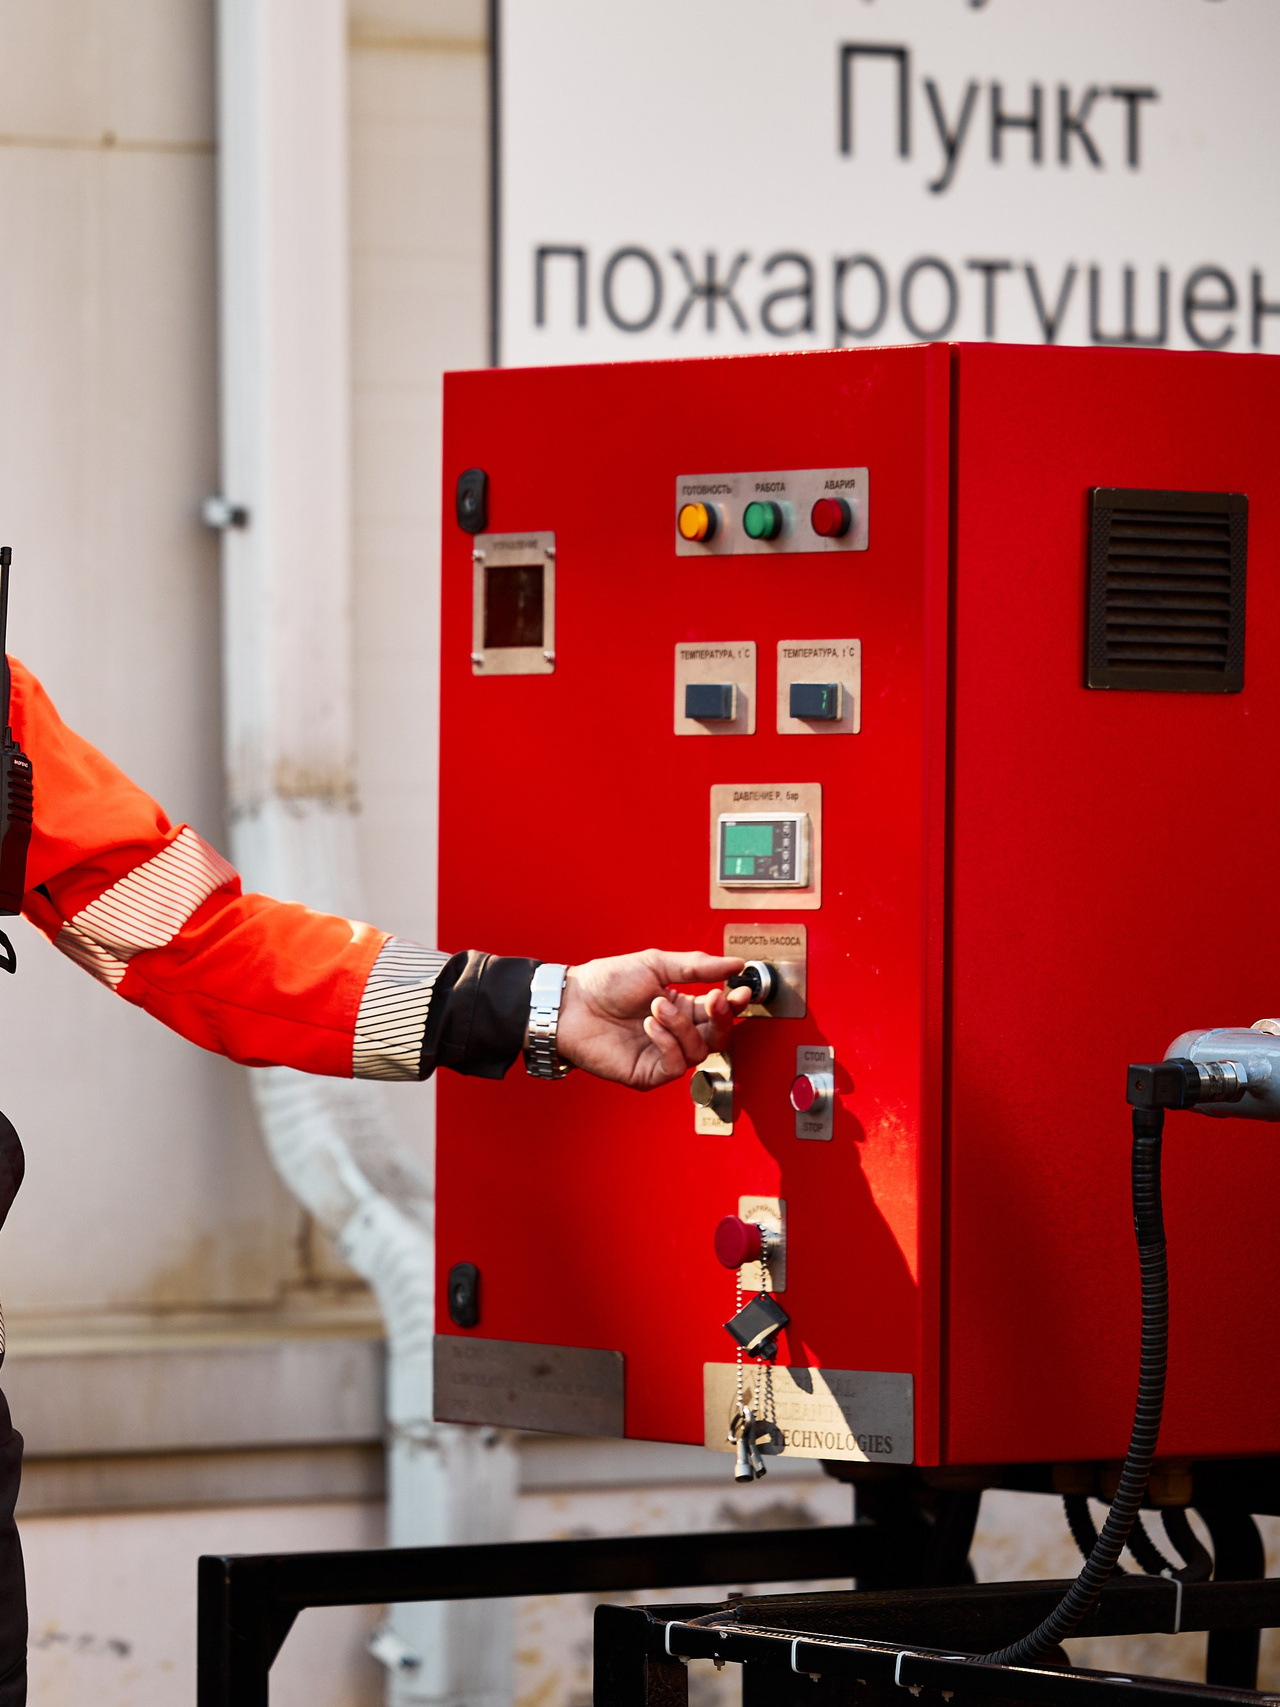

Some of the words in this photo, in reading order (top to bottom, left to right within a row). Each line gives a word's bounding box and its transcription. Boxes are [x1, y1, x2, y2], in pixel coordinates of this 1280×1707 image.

[837, 40, 1160, 195] Пункт
[682, 484, 732, 495] ГОТОВНОСТЬ
[755, 482, 786, 492] РАБОТА
[824, 479, 856, 490] АВАРИЯ
[733, 791, 774, 801] ДАВЛЕНИЕ
[786, 791, 799, 801] бар
[729, 935, 768, 946] СКОРОСТЬ
[769, 936, 801, 946] НАСОСА
[804, 1051, 826, 1062] СТОП
[803, 1122, 824, 1133] STOP
[773, 1428, 893, 1454] TECHNOLOGIES
